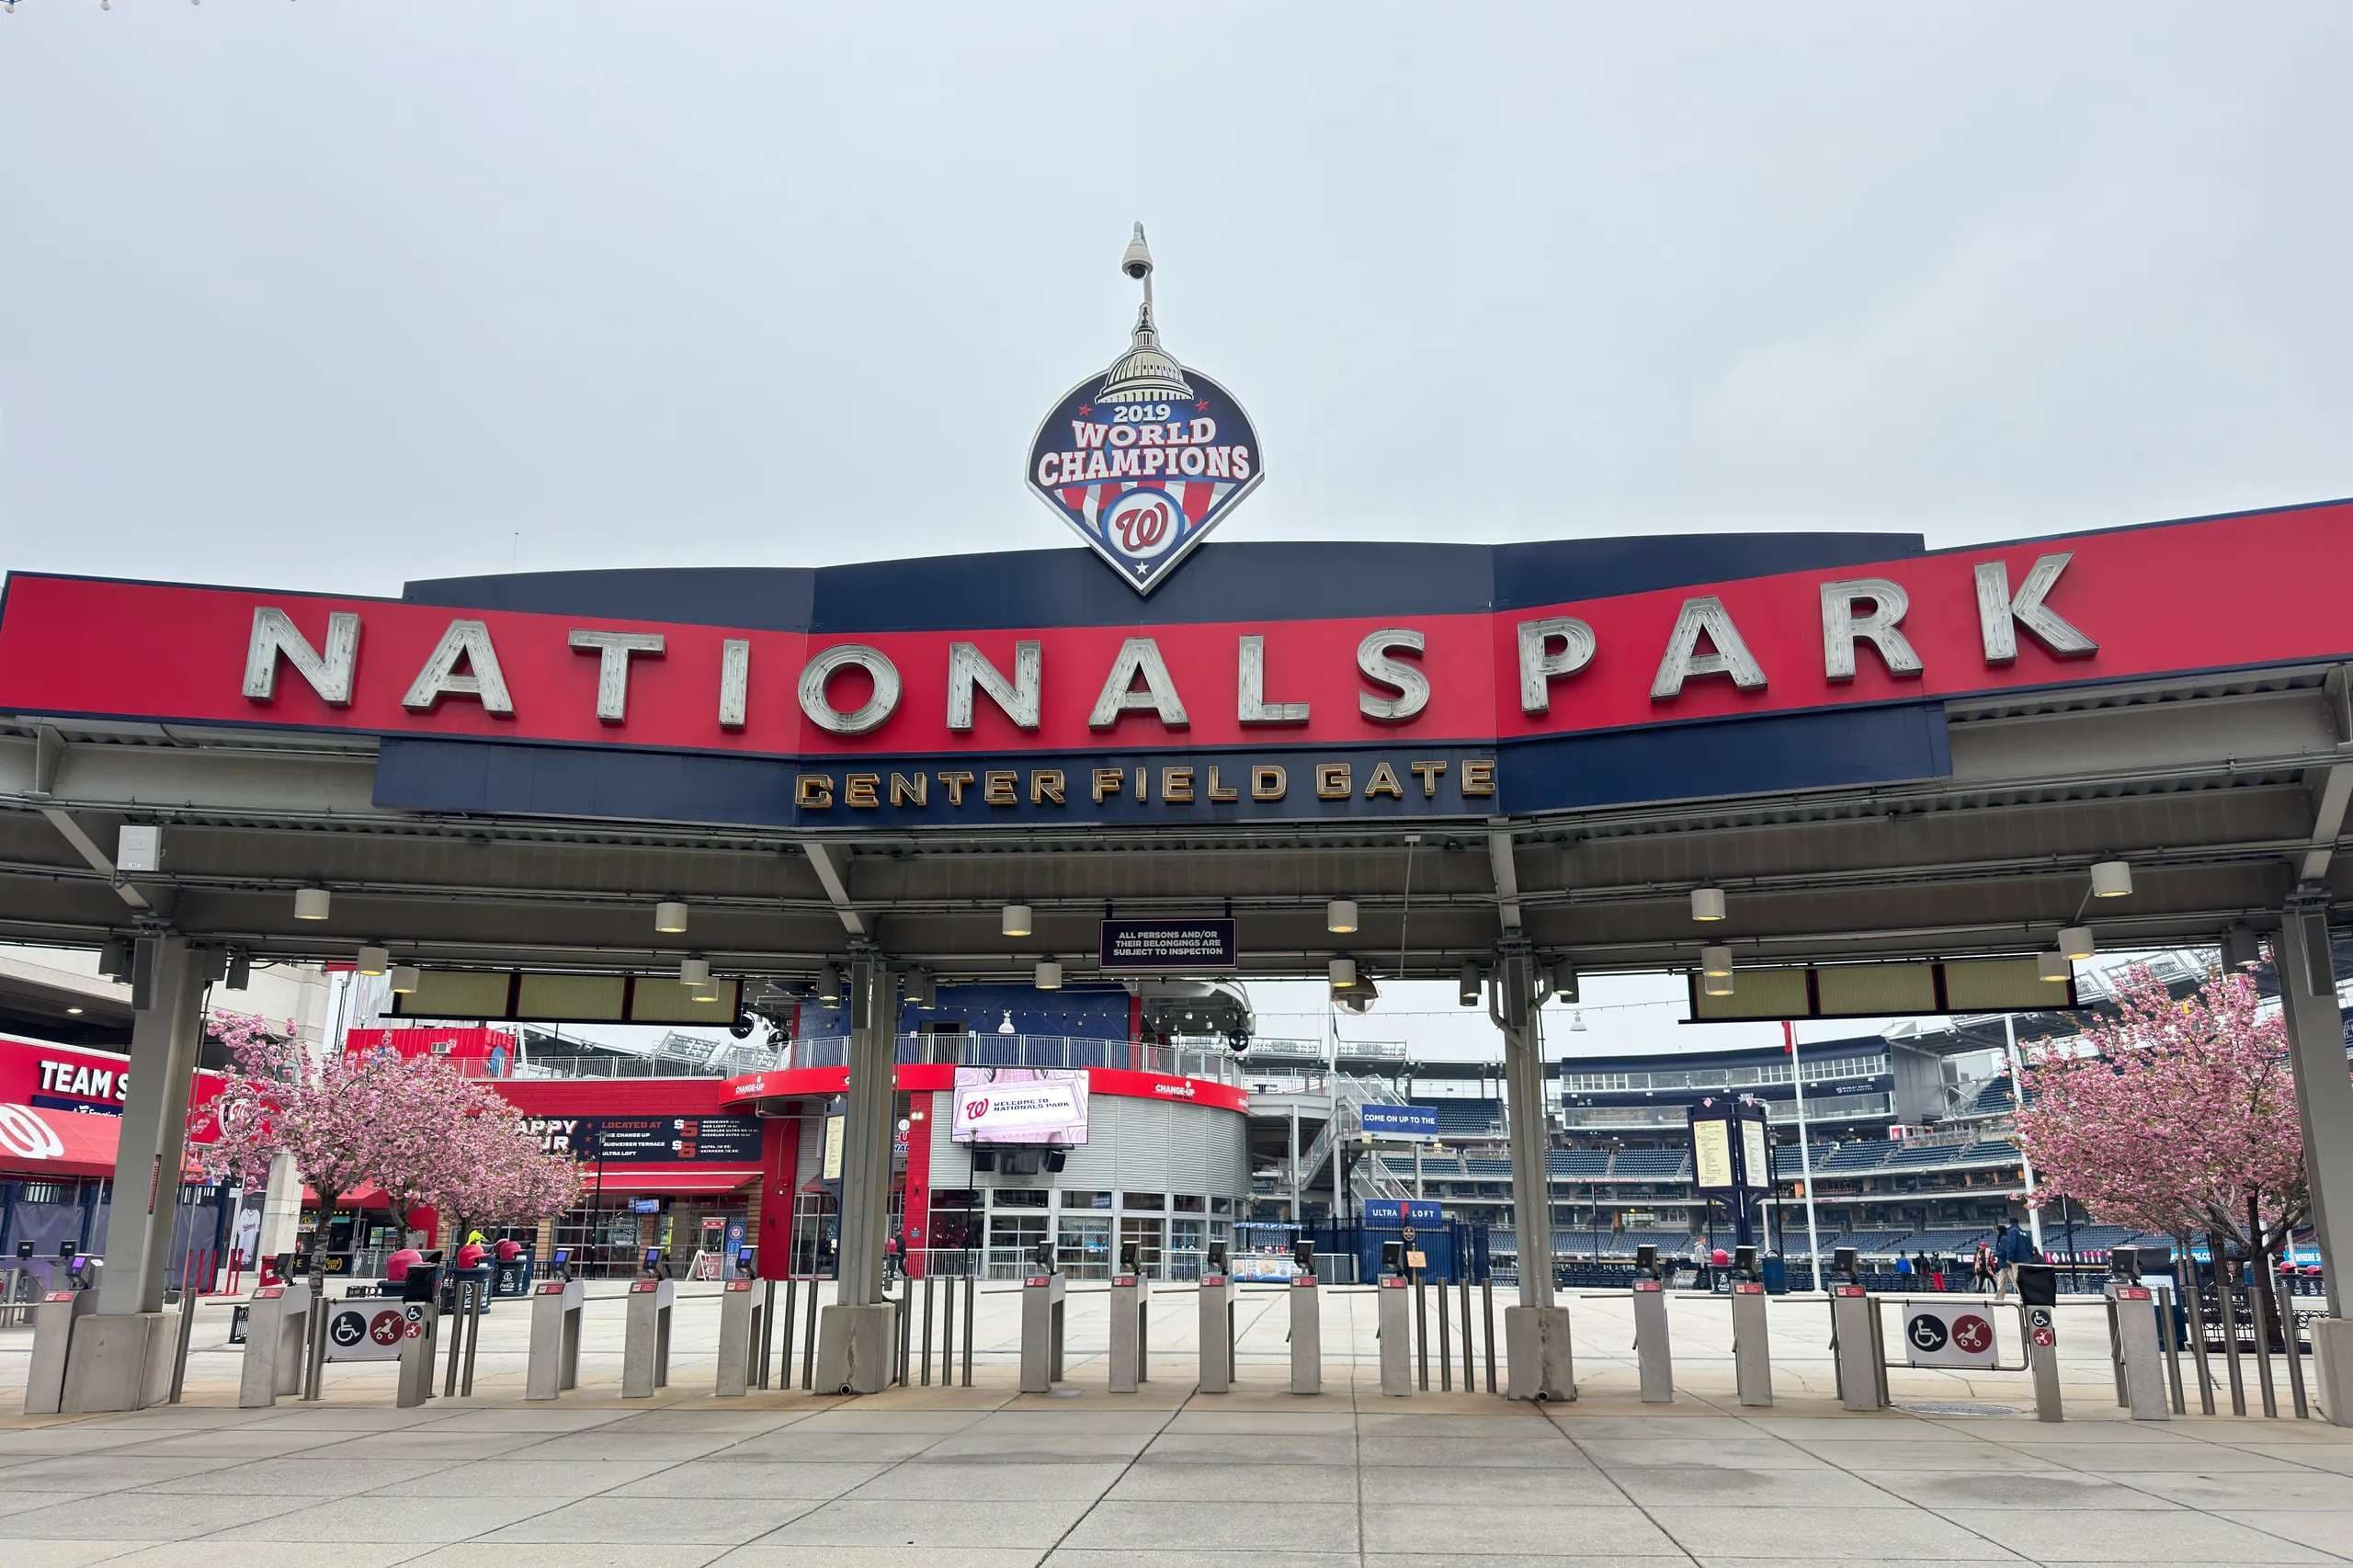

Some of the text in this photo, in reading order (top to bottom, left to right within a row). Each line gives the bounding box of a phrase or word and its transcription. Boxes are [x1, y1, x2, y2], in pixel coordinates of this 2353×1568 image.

[1113, 404, 1171, 423] 2019
[1072, 417, 1217, 449] WORLD
[1038, 446, 1251, 487] CHAMPIONS
[242, 551, 2099, 735] NATIONALS PARK
[795, 759, 1495, 809] CENTER FIELD GATE
[1181, 930, 1218, 938] AND/OR
[40, 1060, 112, 1097] TEAM
[1155, 1085, 1195, 1096] CHANGE-UP
[994, 1103, 1044, 1111] NATIONALS
[517, 1119, 578, 1134] APPY
[1399, 1115, 1409, 1123] UP
[1410, 1116, 1420, 1124] TO
[1421, 1117, 1436, 1125] THE
[1372, 1209, 1435, 1218] ULTRA LOFT
